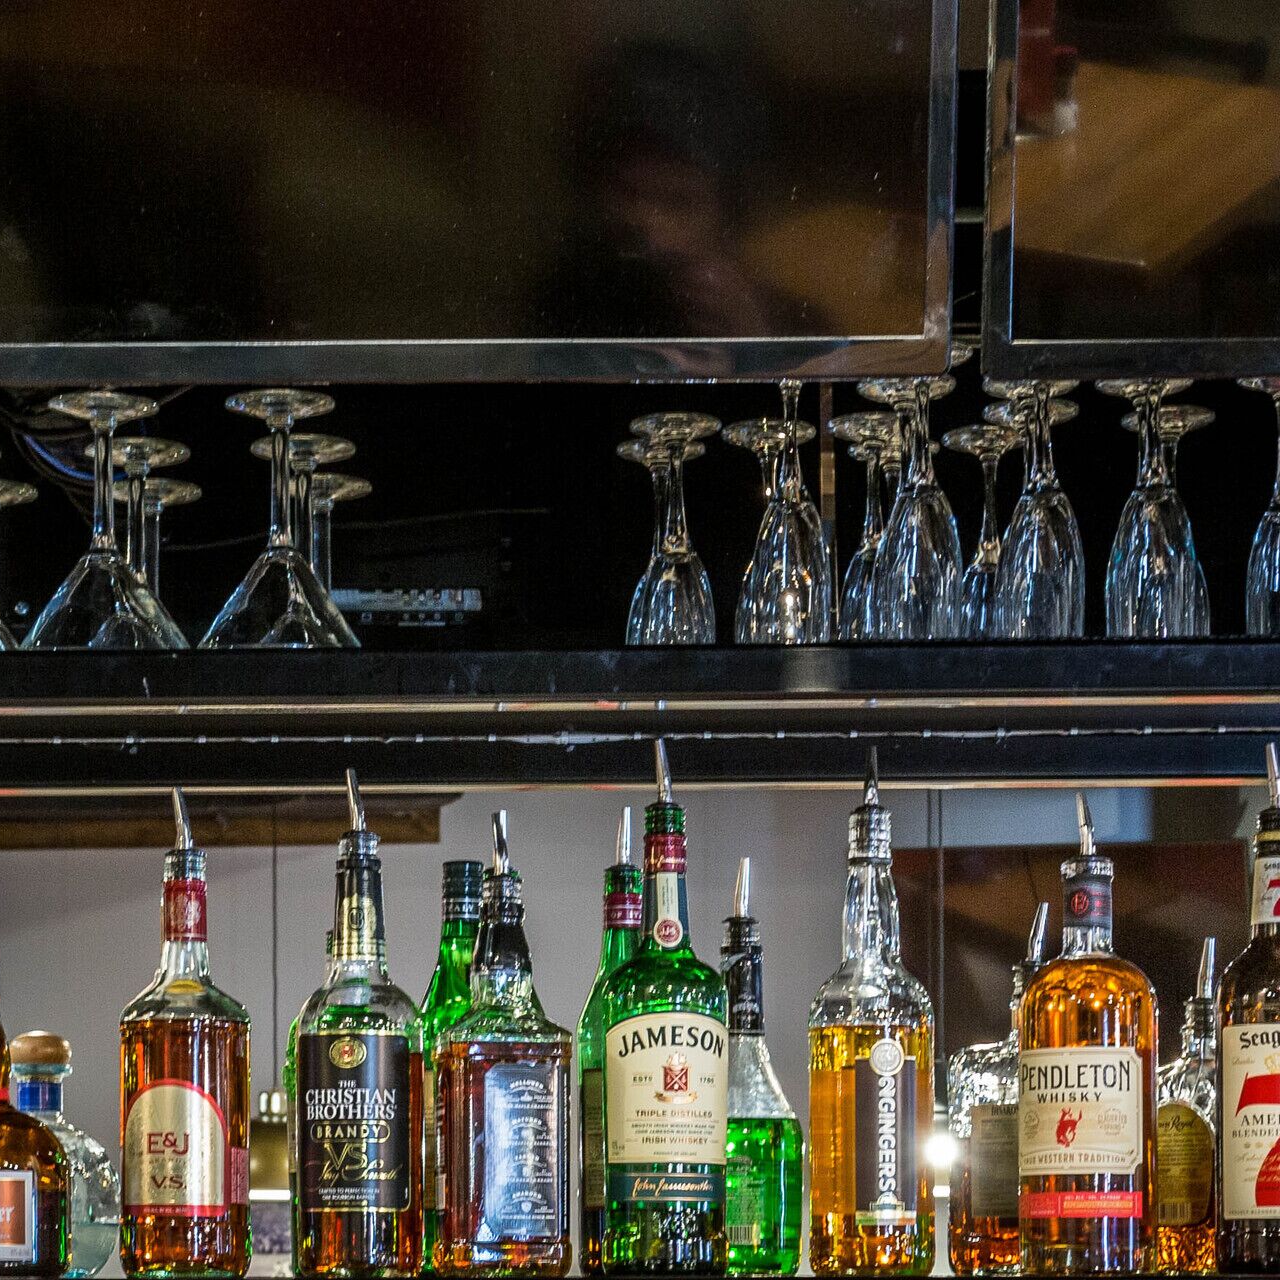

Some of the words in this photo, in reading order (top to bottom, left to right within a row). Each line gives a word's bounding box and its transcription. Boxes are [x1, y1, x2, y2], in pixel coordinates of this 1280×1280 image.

[618, 1025, 725, 1059] JAMESON
[1021, 1060, 1131, 1092] PENDLETON
[338, 1079, 357, 1088] THE
[305, 1087, 397, 1106] CHRISTIAN
[1037, 1092, 1103, 1104] WHISKY
[636, 1109, 668, 1117] TRIPLE
[670, 1109, 713, 1118] DISTILLED
[317, 1125, 382, 1138] BRANDY
[146, 1131, 190, 1156] E&J
[642, 1136, 667, 1145] IRISH
[669, 1136, 709, 1145] WHISKEY
[323, 1141, 368, 1171] VS
[1038, 1153, 1075, 1165] WESTERN
[1078, 1153, 1126, 1164] TRADITION
